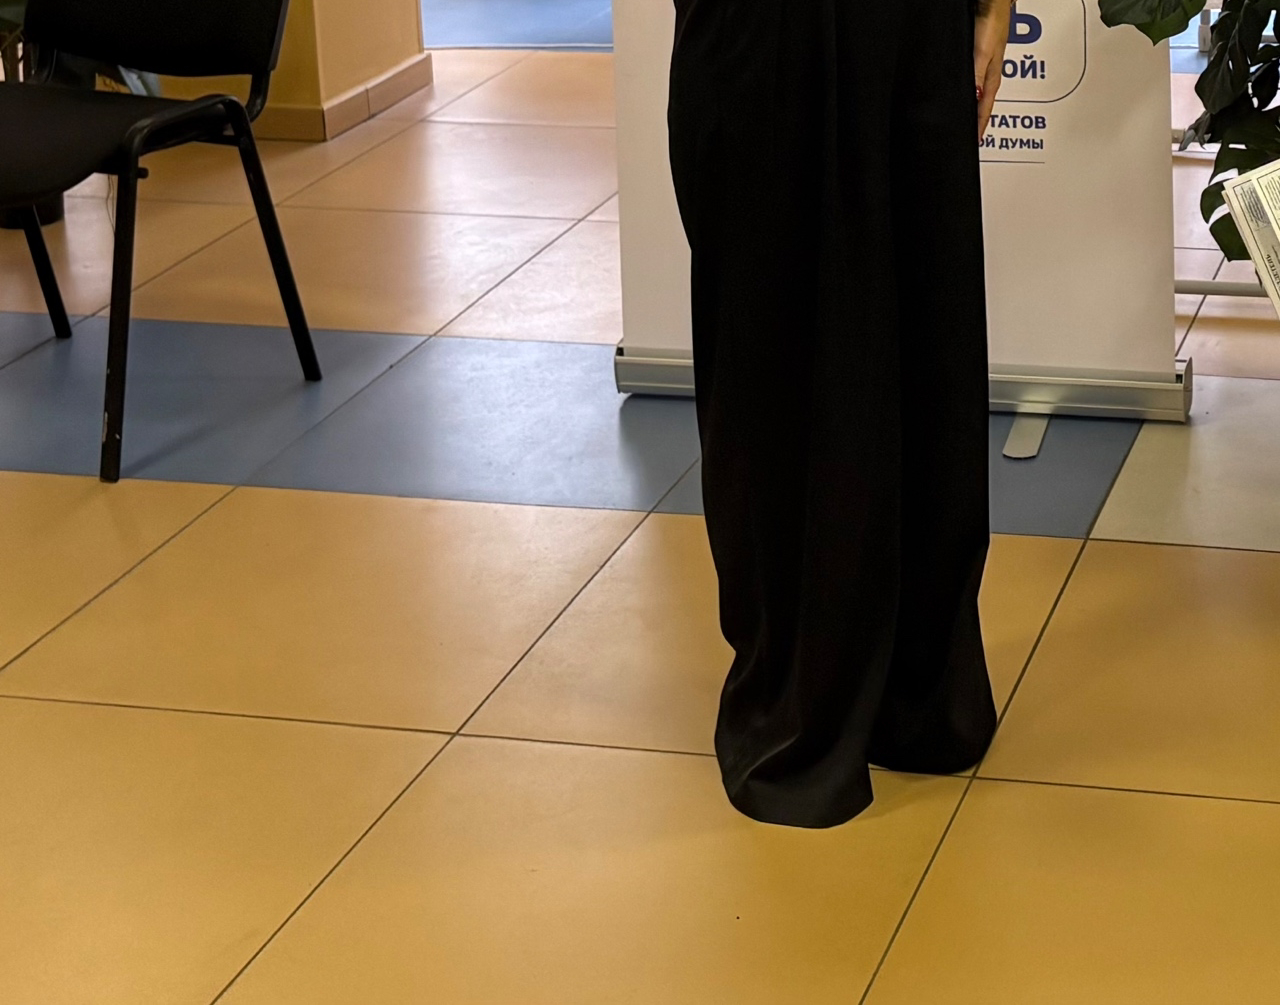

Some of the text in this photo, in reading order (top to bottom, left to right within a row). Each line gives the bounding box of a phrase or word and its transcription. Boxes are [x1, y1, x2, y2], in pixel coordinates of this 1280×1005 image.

[1001, 54, 1046, 80] ОЙ!
[990, 114, 1047, 130] ТАТОВ
[998, 137, 1044, 151] ДУМЫ
